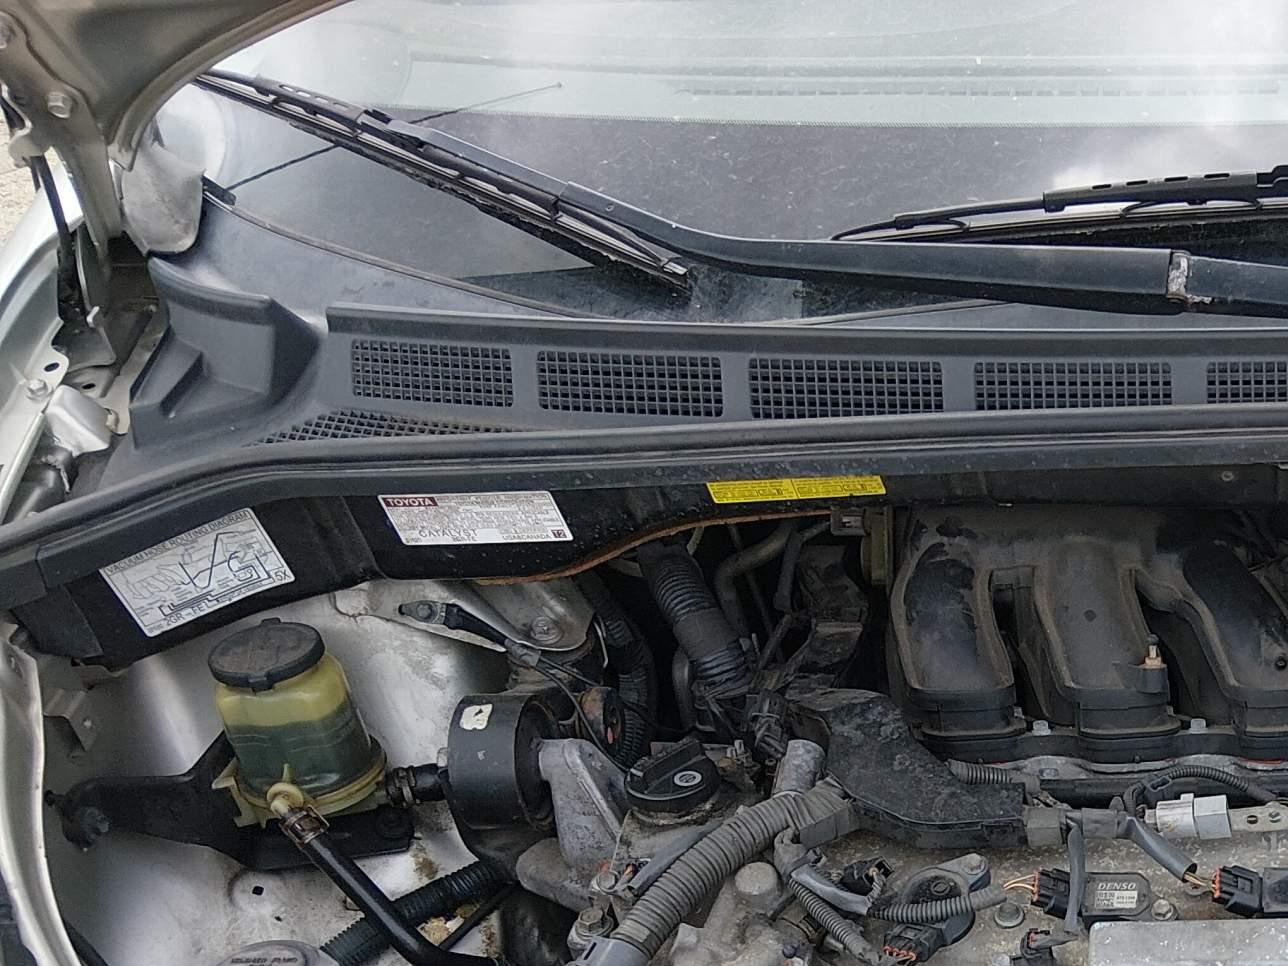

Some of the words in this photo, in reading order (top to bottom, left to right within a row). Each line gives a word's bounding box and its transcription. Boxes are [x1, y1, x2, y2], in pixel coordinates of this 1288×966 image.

[386, 498, 434, 507] TOYOTA
[419, 529, 478, 538] CATALYST
[107, 552, 146, 574] VACUUM
[145, 543, 171, 561] HOSE
[170, 527, 209, 549] ROUTING
[208, 512, 248, 535] DIAGRAM
[274, 569, 291, 582] 5X
[1097, 882, 1137, 890] DENSO
